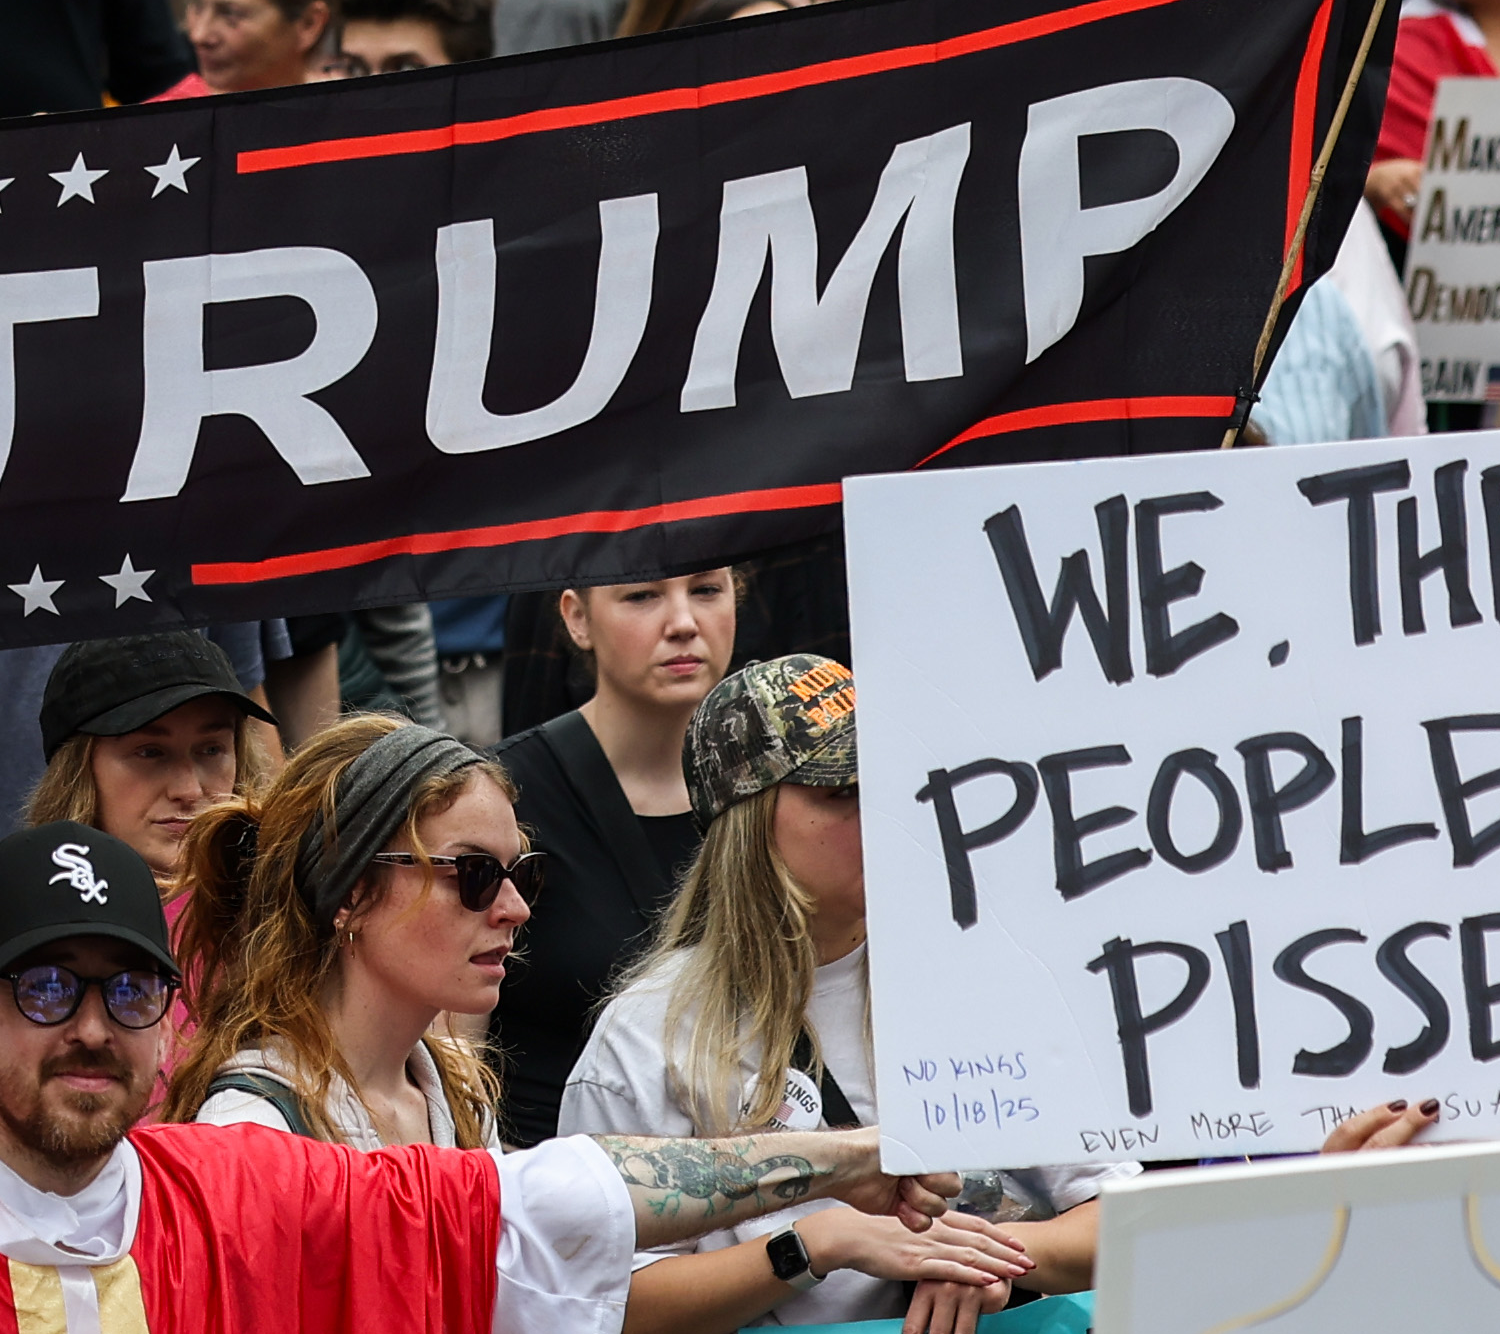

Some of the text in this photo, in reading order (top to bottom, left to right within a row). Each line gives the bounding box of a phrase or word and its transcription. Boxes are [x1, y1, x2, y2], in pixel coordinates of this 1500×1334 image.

[1419, 357, 1480, 399] GAIN
[902, 1052, 1029, 1087] NO KINGS
[920, 1088, 1042, 1134] 10/18/25
[1078, 1124, 1163, 1157] EVEN
[1186, 1107, 1277, 1143] MORE
[1299, 1101, 1368, 1137] THA
